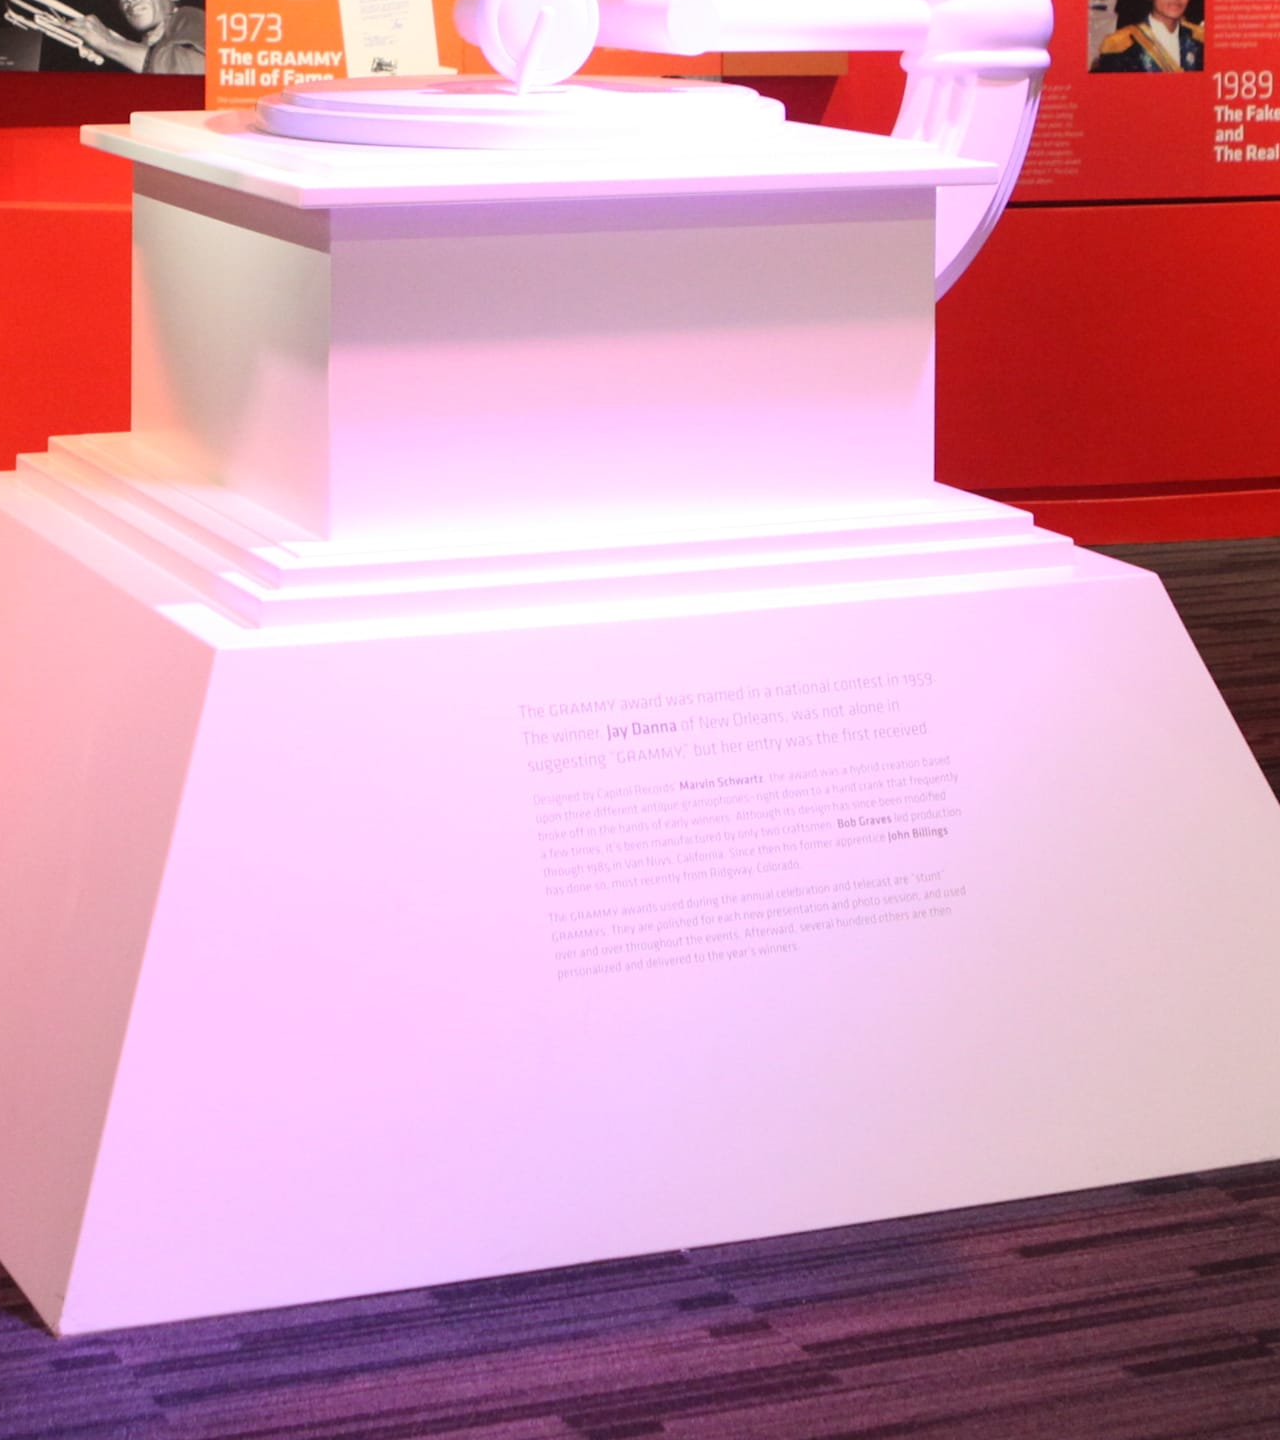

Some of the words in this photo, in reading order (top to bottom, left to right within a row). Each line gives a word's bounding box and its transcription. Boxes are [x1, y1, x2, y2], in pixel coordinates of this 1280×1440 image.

[216, 12, 283, 43] 1973
[218, 48, 253, 66] The
[256, 50, 343, 67] GRAMMY
[219, 68, 256, 86] Hall
[260, 68, 280, 87] of
[1213, 71, 1274, 99] 1989
[1214, 105, 1242, 122] The
[1215, 124, 1244, 141] and
[1214, 145, 1242, 162] The
[1246, 144, 1280, 161] Real
[518, 703, 544, 720] The
[548, 699, 616, 717] GRAMMY
[620, 693, 662, 711] award
[666, 694, 694, 708] was
[696, 686, 744, 705] named
[748, 685, 760, 701] in
[764, 687, 772, 699] a
[776, 678, 830, 698] national
[834, 674, 884, 693] contest
[886, 673, 900, 689] in
[904, 670, 936, 688] 1959.
[522, 729, 549, 746] The
[607, 722, 628, 742] Jay
[632, 720, 677, 736] Danna
[681, 715, 694, 732] of
[698, 714, 729, 730] New
[792, 708, 819, 722] was
[822, 702, 844, 720] not
[848, 701, 884, 717] alone
[888, 698, 900, 714] in
[528, 751, 607, 775] suggesting
[694, 739, 717, 756] but
[720, 738, 742, 754] her
[746, 734, 782, 753] entry
[785, 733, 814, 748] was
[816, 728, 840, 745] the
[842, 724, 870, 742] first
[680, 777, 716, 791] Marvin
[836, 816, 856, 829] Bob
[859, 814, 892, 827] Graves
[888, 829, 910, 845] John
[912, 826, 948, 840] Billings
[558, 960, 622, 981] personalized
[624, 958, 644, 971] and
[646, 952, 692, 969] delivered
[707, 949, 722, 962] the
